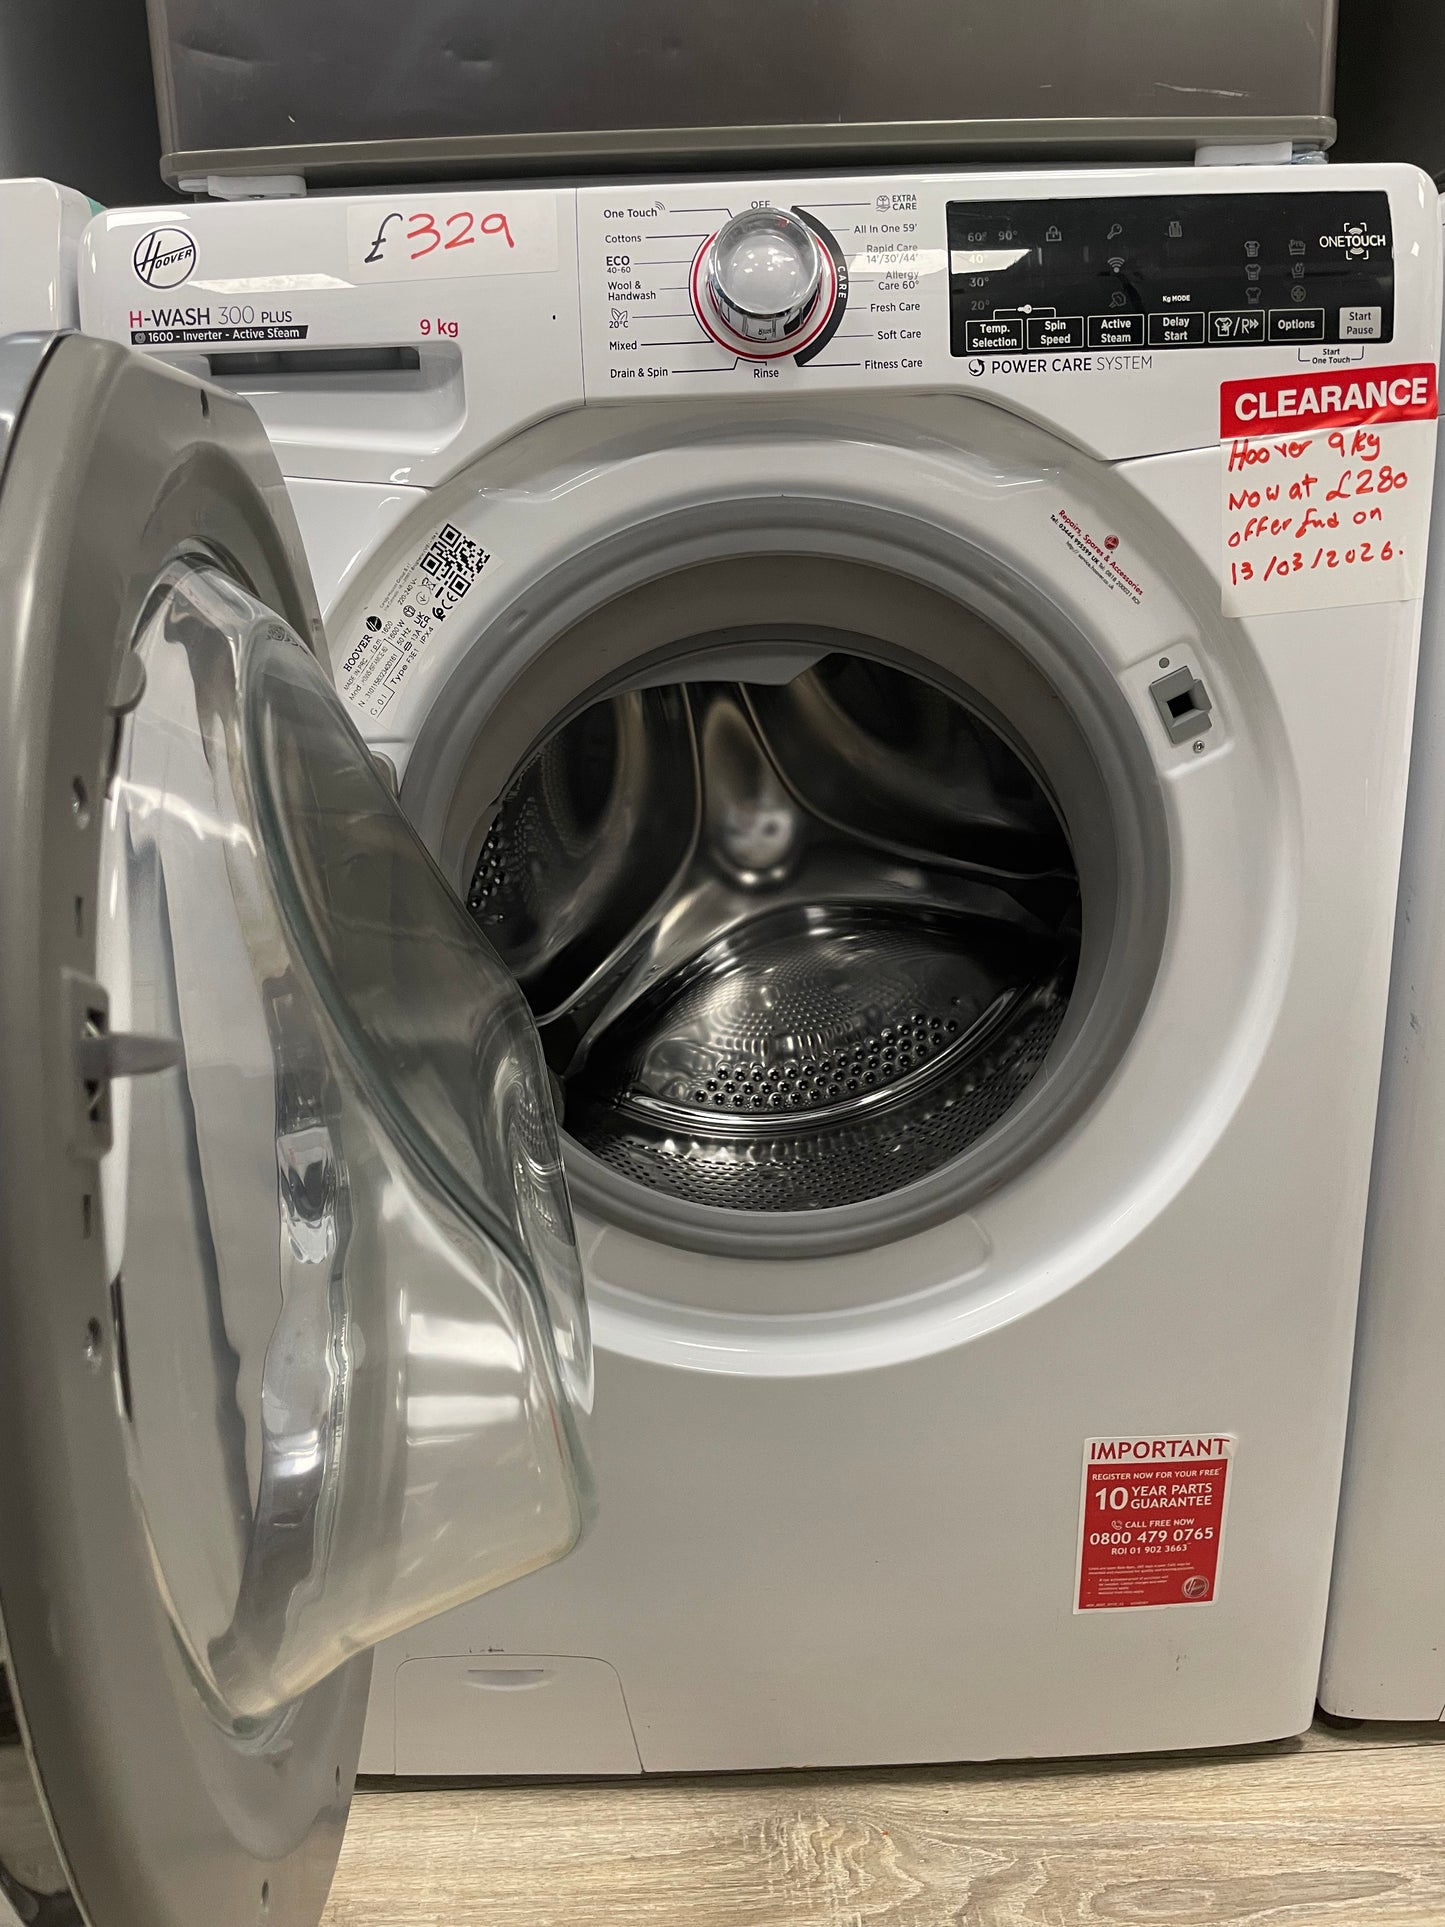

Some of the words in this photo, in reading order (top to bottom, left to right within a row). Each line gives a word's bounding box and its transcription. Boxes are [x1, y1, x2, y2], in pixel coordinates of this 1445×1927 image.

[892, 194, 917, 202] EXTRA
[751, 200, 771, 209] OFF
[892, 202, 917, 211] CARE
[603, 209, 624, 219] One
[627, 207, 658, 218] Touch
[854, 225, 867, 234] All
[869, 224, 878, 234] In
[881, 224, 900, 233] One
[364, 212, 515, 263] £329
[604, 234, 642, 244] Cottons
[1318, 234, 1387, 249] ONETOUCH
[866, 243, 894, 253] Rapid
[896, 243, 918, 252] Care
[606, 255, 630, 266] ECO
[606, 266, 632, 274] 40-60
[885, 270, 919, 280] Allergy
[608, 281, 632, 290] Wool
[634, 280, 642, 290] &
[837, 265, 848, 299] CARE
[878, 281, 900, 291] Care
[608, 290, 657, 302] Handwash
[1162, 295, 1172, 303] Kg
[1172, 294, 1191, 302] MODE
[870, 303, 897, 313] Fresh
[898, 302, 921, 312] Care
[129, 307, 210, 328] H-WASH
[218, 305, 255, 325] 300
[261, 311, 293, 323] PLUS
[1349, 311, 1372, 321] Start
[1044, 321, 1067, 332] Spin
[1100, 318, 1132, 330] Active
[1162, 316, 1190, 328] Delay
[1277, 319, 1316, 332] Options
[420, 318, 431, 336] 9
[434, 318, 459, 339] kg
[979, 323, 1011, 334] Temp.
[1346, 326, 1374, 336] Pause
[149, 331, 174, 342] 1600
[183, 329, 223, 342] Inverter
[233, 328, 265, 340] Active
[267, 327, 300, 339] Steam
[877, 330, 897, 340] Soft
[899, 329, 922, 339] Care
[1040, 334, 1071, 345] Speed
[1100, 332, 1132, 343] Steam
[1164, 330, 1188, 341] Start
[609, 340, 638, 351] Mixed
[972, 337, 1018, 348] Selection
[1322, 348, 1341, 356] Start
[864, 359, 899, 370] Fitness
[900, 358, 923, 368] Care
[991, 358, 1048, 374] POWER
[1051, 357, 1092, 372] CARE
[1096, 355, 1153, 371] SYSTEM
[1311, 357, 1327, 365] One
[1328, 356, 1351, 365] Touch
[610, 368, 636, 379] Drain
[637, 367, 645, 377] &
[647, 366, 669, 378] Spin
[753, 367, 779, 378] Rinse
[1235, 377, 1428, 422] CLEARANCE
[1325, 465, 1409, 502] £280
[1352, 506, 1383, 526] on
[1058, 523, 1075, 539] 03444
[1058, 509, 1081, 537] Repairs,
[1083, 534, 1104, 557] Spares
[1109, 561, 1143, 596] Accessories
[381, 620, 393, 635] 1600
[387, 626, 400, 641] 1600
[396, 619, 405, 628] W
[400, 627, 412, 638] Hz
[410, 629, 422, 641] 13A
[396, 637, 405, 646] 50
[343, 634, 373, 672] HOOVER
[390, 664, 408, 685] Type
[419, 626, 434, 644] IPX4
[343, 675, 355, 690] MADE
[1090, 1438, 1230, 1460] IMPORTANT
[1092, 1473, 1131, 1481] REGISTER
[1133, 1472, 1153, 1480] NOW
[1155, 1471, 1173, 1479] FOR
[1175, 1470, 1197, 1478] YOUR
[1095, 1486, 1129, 1511] 10
[1132, 1485, 1167, 1497] YEAR
[1171, 1483, 1213, 1495] PARTS
[1130, 1495, 1213, 1510] GUARANTEE
[1125, 1521, 1148, 1529] CALL
[1150, 1519, 1172, 1527] FREE
[1173, 1518, 1195, 1526] NOW
[1089, 1532, 1132, 1546] 0800
[1136, 1530, 1168, 1544] 479
[1173, 1527, 1214, 1541] 0765
[1111, 1547, 1128, 1556] ROI
[1129, 1547, 1141, 1555] 01
[1144, 1545, 1162, 1554] 902
